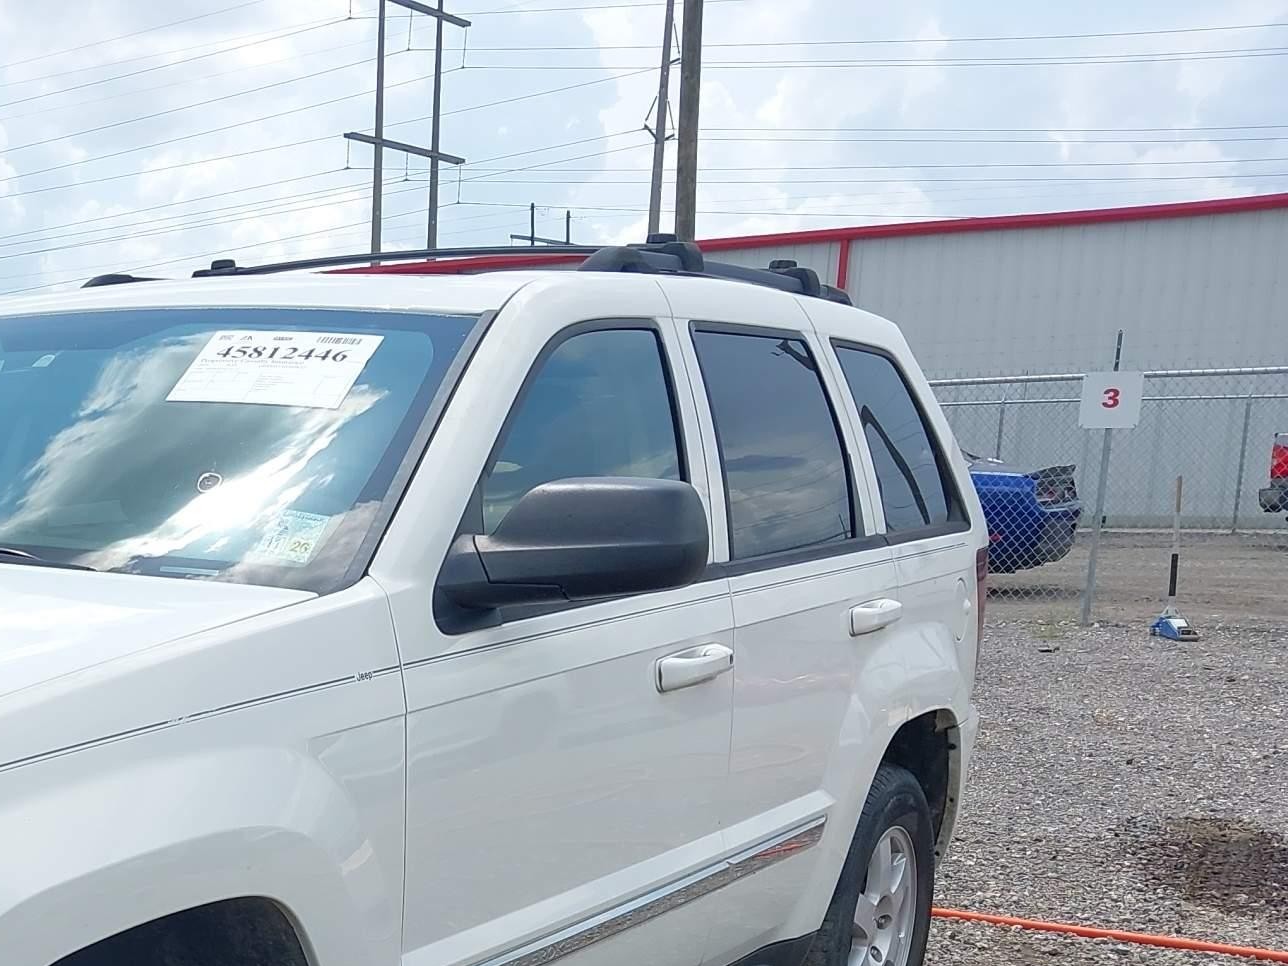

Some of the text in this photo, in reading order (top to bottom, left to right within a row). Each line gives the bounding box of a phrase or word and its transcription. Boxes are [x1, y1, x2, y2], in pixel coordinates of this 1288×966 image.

[216, 345, 352, 363] 45812446
[1101, 388, 1120, 409] 3
[356, 671, 373, 682] Jeep
